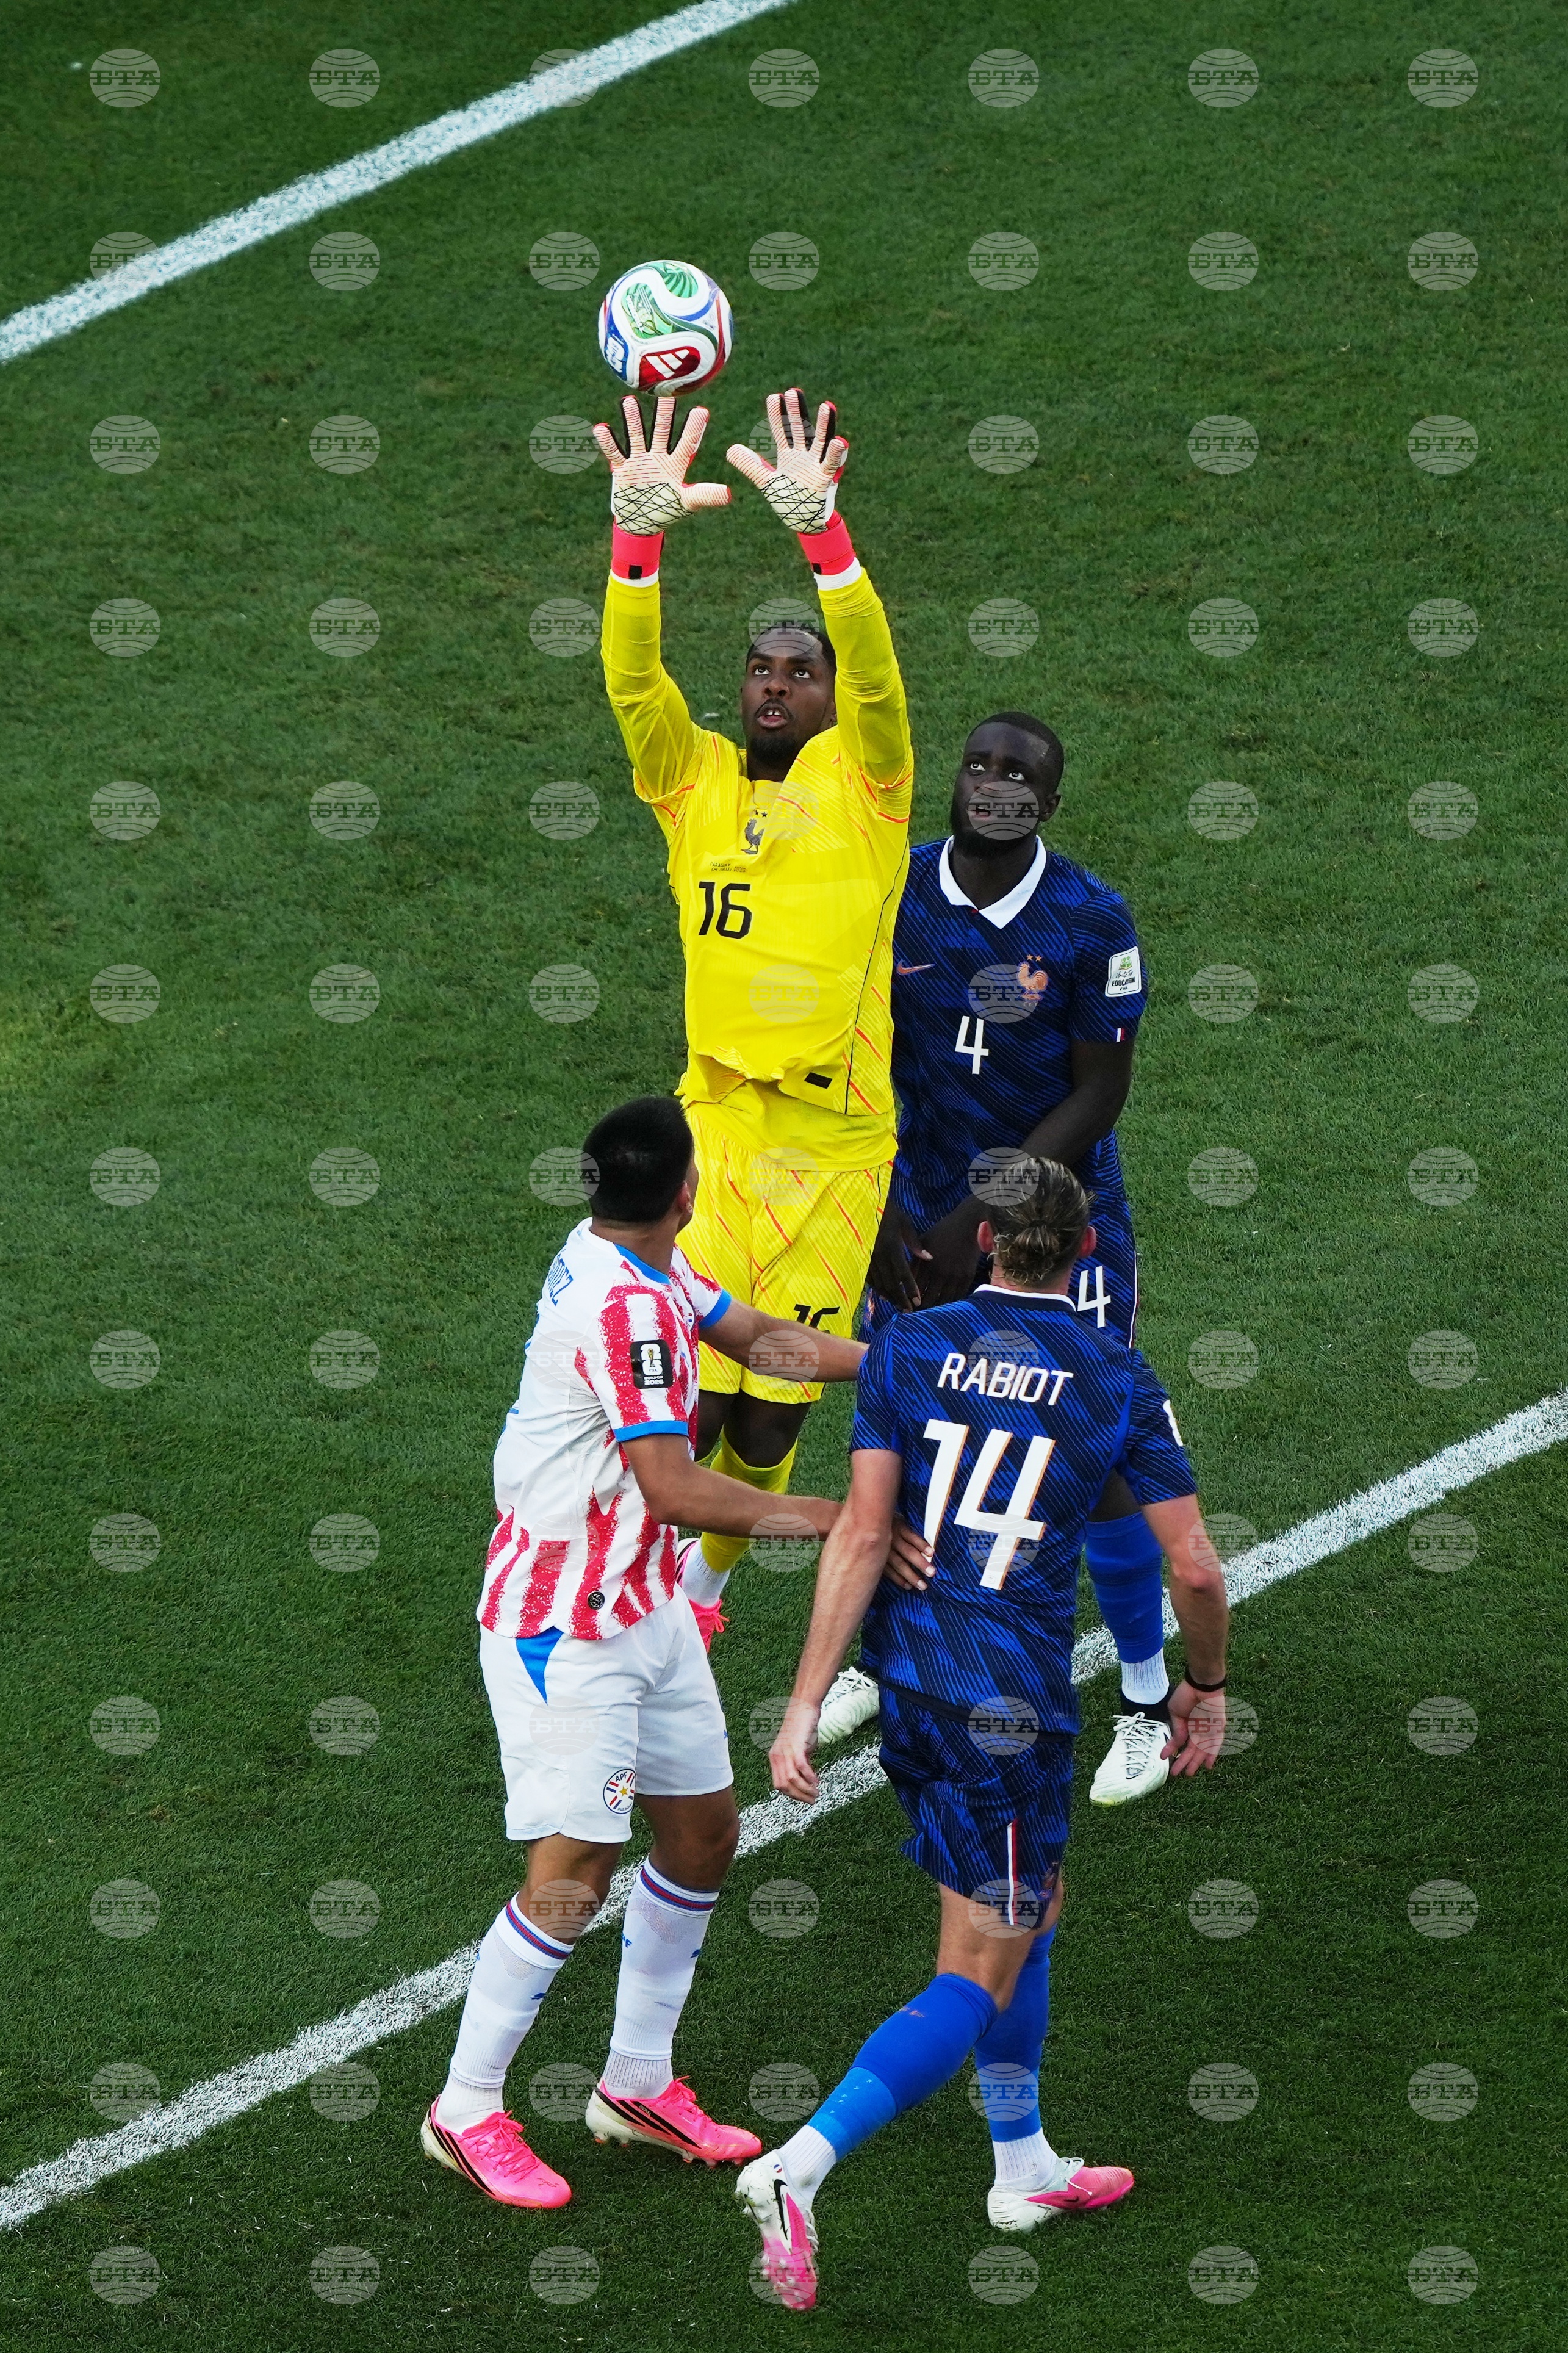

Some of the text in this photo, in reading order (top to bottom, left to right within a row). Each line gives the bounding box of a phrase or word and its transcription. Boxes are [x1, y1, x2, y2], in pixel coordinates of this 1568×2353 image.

[699, 881, 752, 939] 16
[955, 1015, 989, 1075] 4
[1077, 1266, 1111, 1328] 4
[937, 1353, 1074, 1406] RABIOT
[923, 1419, 1056, 1590] 14
[616, 1771, 628, 1782] APF
